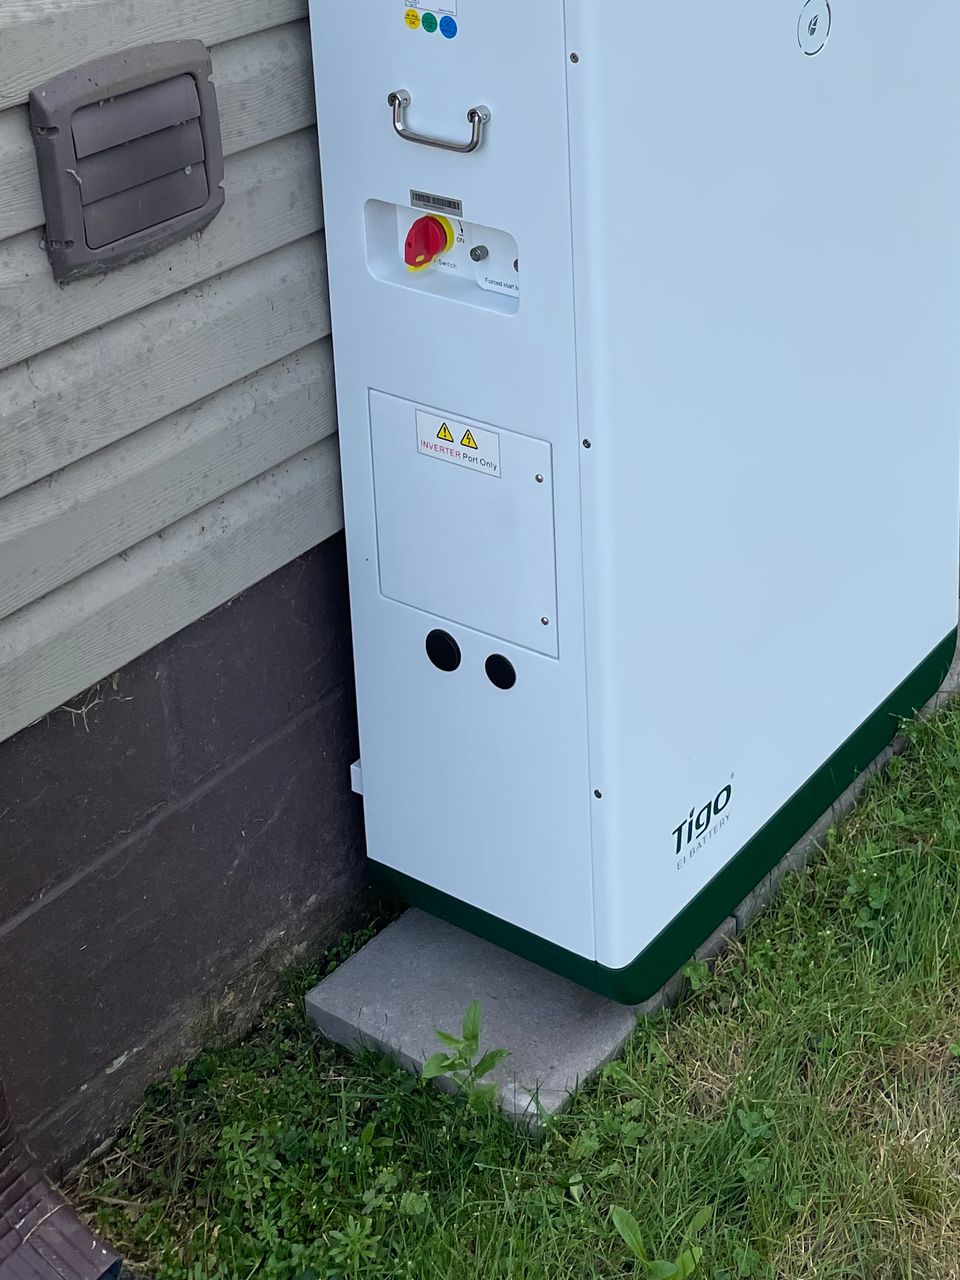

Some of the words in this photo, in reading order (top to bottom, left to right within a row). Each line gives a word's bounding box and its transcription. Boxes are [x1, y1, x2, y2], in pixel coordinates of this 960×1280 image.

[484, 277, 503, 287] Forced
[503, 282, 515, 290] start
[420, 439, 461, 459] INVERTER
[462, 452, 479, 465] Port
[479, 458, 498, 472] Only
[671, 783, 732, 855] Tigo
[689, 814, 730, 859] BATTERY
